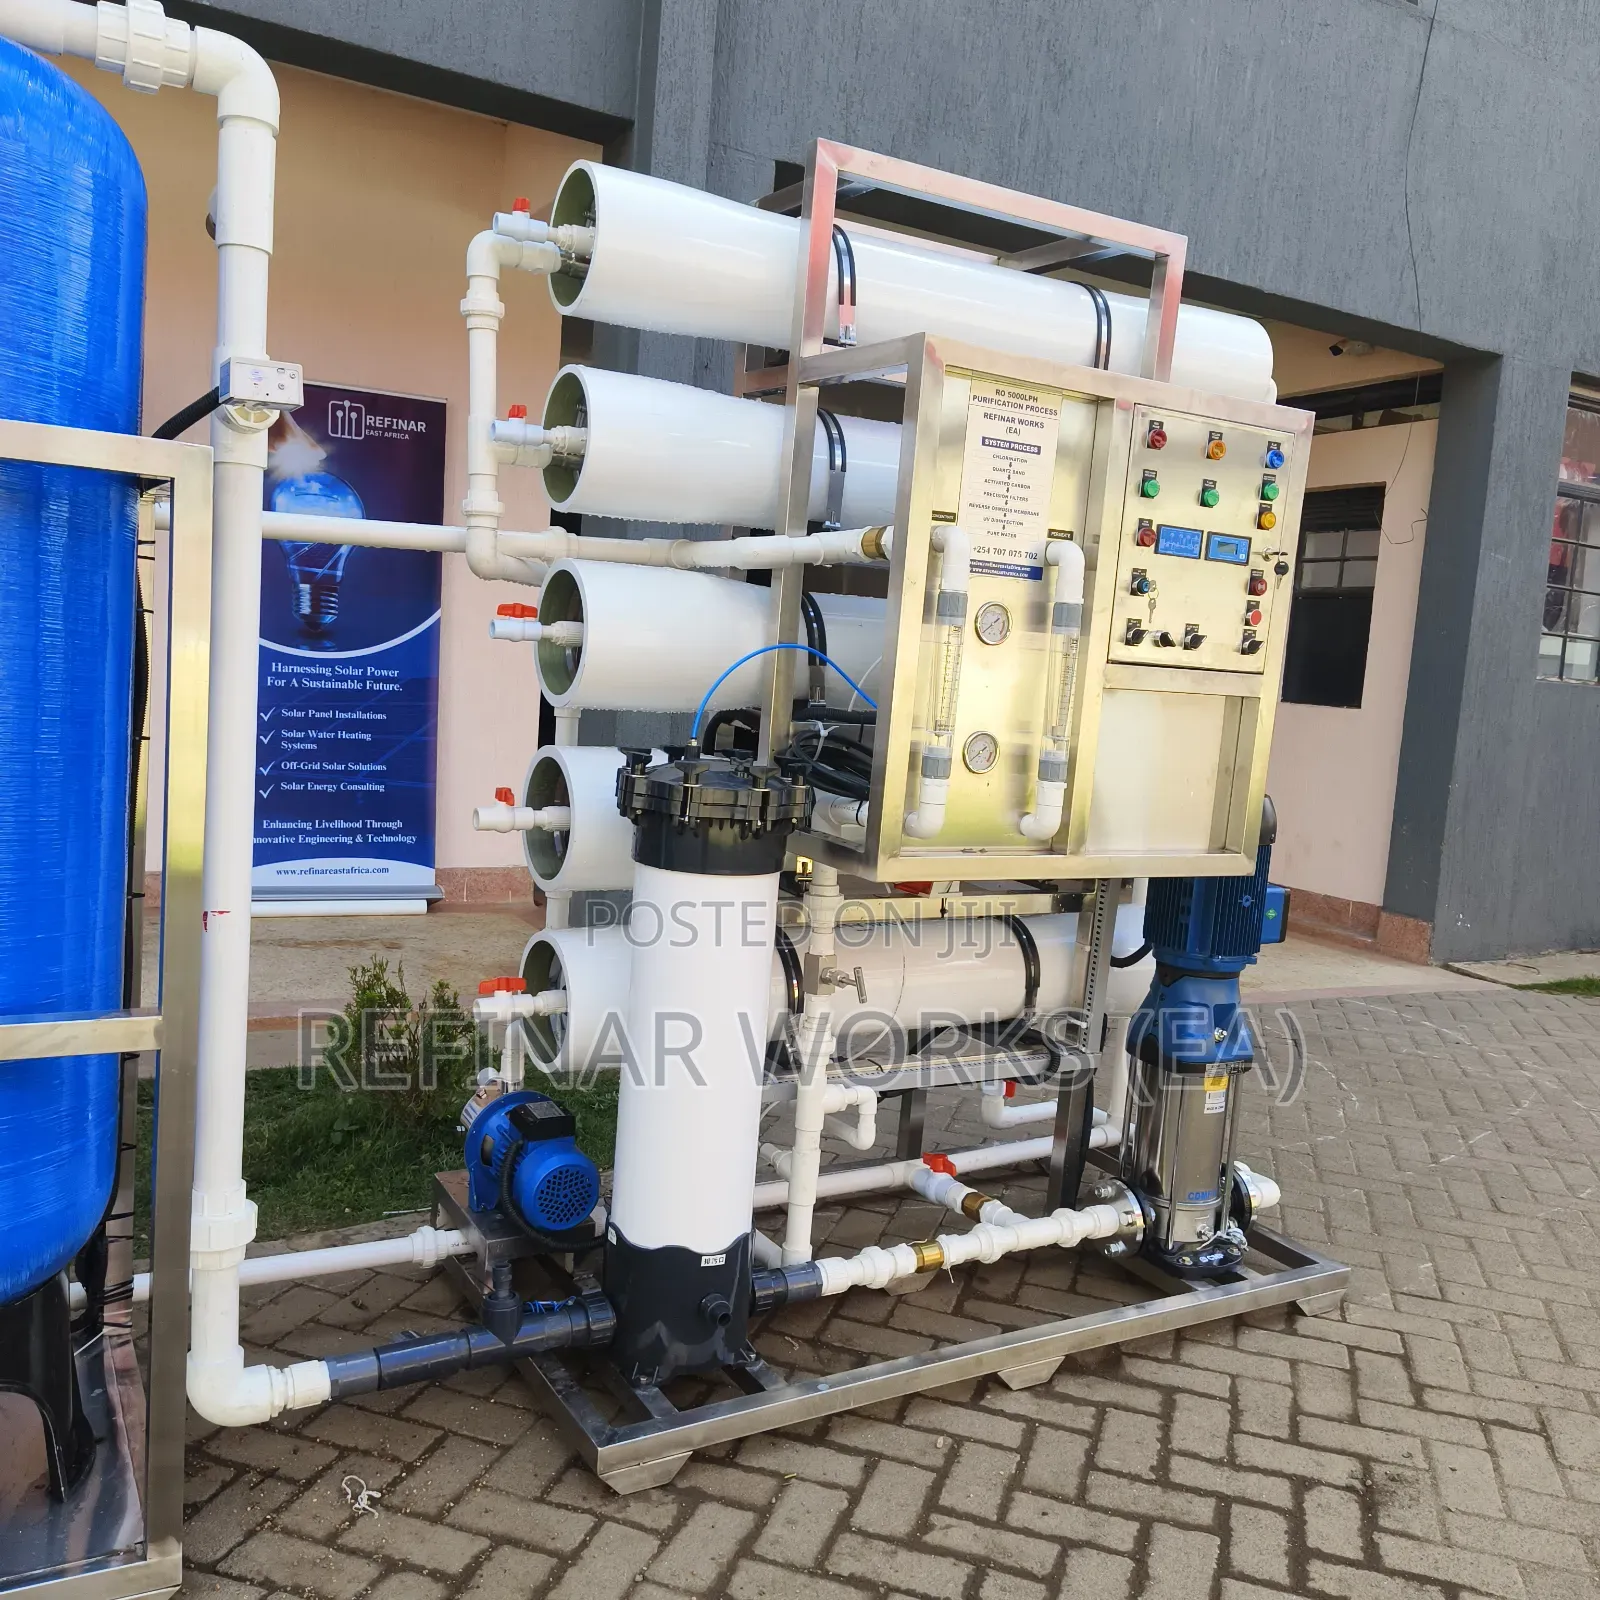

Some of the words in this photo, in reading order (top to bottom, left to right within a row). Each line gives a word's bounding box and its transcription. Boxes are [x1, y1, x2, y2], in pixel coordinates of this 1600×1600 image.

[996, 388, 1006, 396] RO
[1008, 391, 1038, 403] 5000LPH
[972, 394, 1024, 410] PURIFICATION
[1026, 404, 1058, 416] PROCESS
[366, 415, 426, 432] REFINAR
[984, 412, 1016, 424] REFINAR
[1018, 418, 1044, 429] WORKS
[366, 429, 382, 437] EAST
[384, 431, 409, 440] AFRICA
[1006, 426, 1021, 436] (EA)
[984, 439, 1010, 448] SYSTEM
[1011, 442, 1038, 453] PROCESS
[992, 454, 1028, 464] CHLORINATION
[973, 546, 990, 554] +254
[993, 548, 1006, 556] 707
[1008, 550, 1022, 558] 075
[1025, 552, 1038, 560] 702
[271, 662, 332, 676] Harnessing
[334, 665, 363, 676] Solar
[367, 666, 399, 677] Power
[267, 676, 286, 687] For
[290, 678, 298, 688] A
[302, 678, 363, 690] Sustainable
[366, 681, 402, 692] Future.
[281, 708, 305, 718] Solar
[308, 709, 333, 718] Panel
[336, 710, 386, 720] Installations
[281, 729, 305, 738] Solar
[308, 730, 336, 739] Water
[337, 731, 372, 742] Heating
[281, 741, 318, 751] Systems
[281, 761, 320, 770] Off-Grid
[322, 762, 346, 771] Solar
[348, 762, 386, 771] Solutions
[280, 782, 305, 790] Solar
[308, 782, 337, 792] Energy
[340, 782, 385, 792] Consulting
[263, 820, 312, 830] Enhancing
[315, 820, 362, 828] Livelihood
[365, 820, 403, 830] Through
[253, 835, 295, 844] nnovative
[299, 834, 353, 845] Engineering
[356, 834, 363, 843] &
[367, 834, 417, 844] Technology
[276, 866, 389, 876] www.refinareastafrica.com
